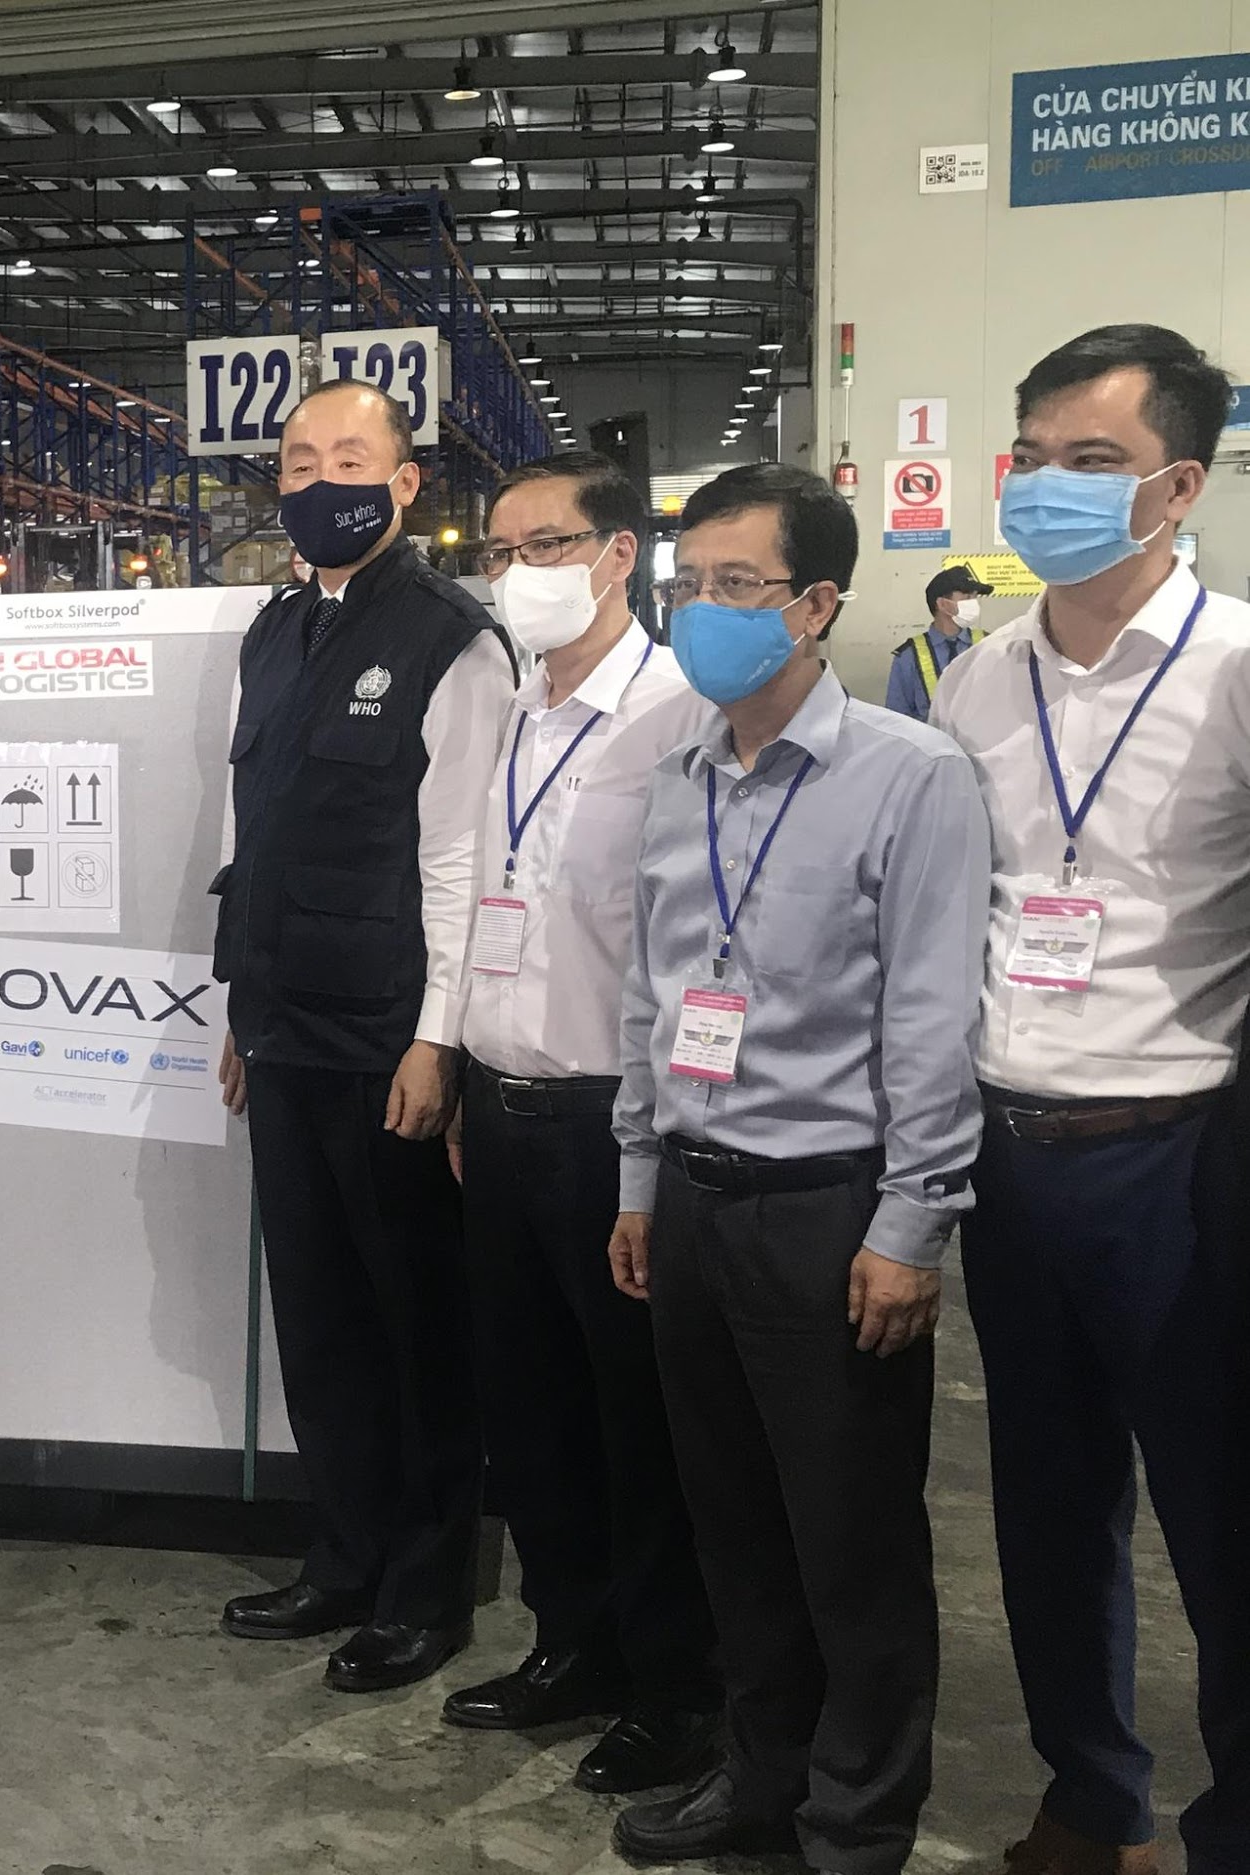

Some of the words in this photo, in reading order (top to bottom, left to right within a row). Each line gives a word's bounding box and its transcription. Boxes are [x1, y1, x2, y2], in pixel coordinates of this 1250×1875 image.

[1033, 83, 1092, 119] CỬA
[1101, 69, 1217, 112] CHUYỂN
[1032, 120, 1111, 152] HÀNG
[1120, 111, 1221, 145] KHÔNG
[200, 349, 291, 442] I22
[909, 405, 935, 444] 1
[6, 606, 63, 619] Softbox
[14, 647, 147, 671] GLOBAL
[349, 702, 381, 716] WHO
[1, 1040, 27, 1053] Gavi
[64, 1047, 110, 1063] unicef
